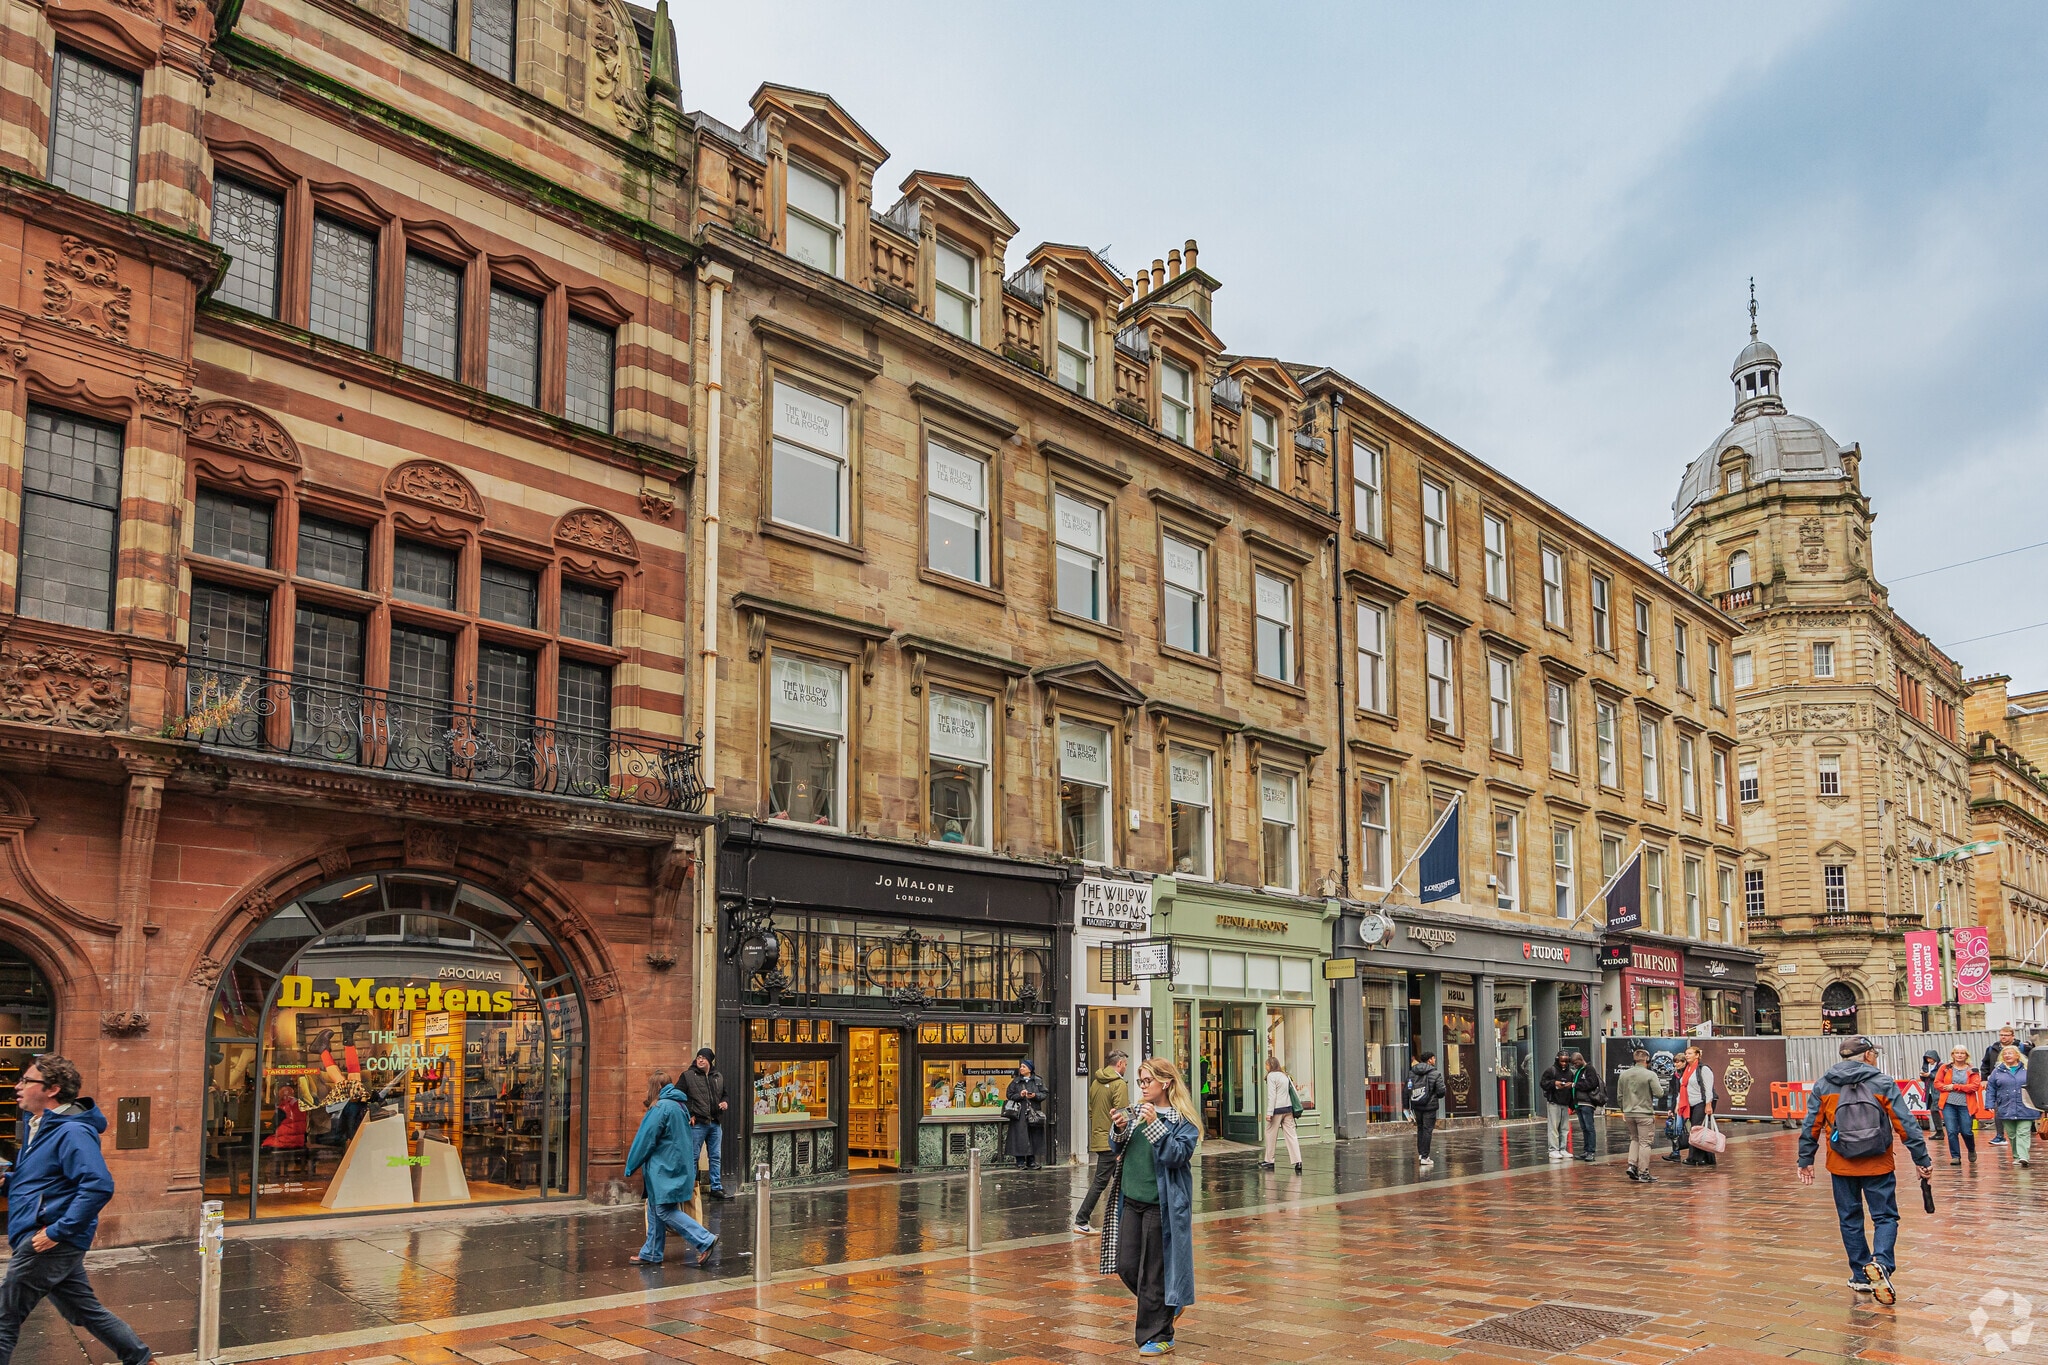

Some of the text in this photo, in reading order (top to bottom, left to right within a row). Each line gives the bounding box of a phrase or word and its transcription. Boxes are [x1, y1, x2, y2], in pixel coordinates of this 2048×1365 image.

[785, 403, 829, 428] THE WILLOW
[785, 413, 828, 437] TEA ROOMS
[936, 461, 972, 482] THE WILLOW
[937, 470, 972, 491] TEA ROOMS
[1061, 510, 1092, 528] THE WILLOW
[1062, 519, 1091, 536] TEA ROOMS
[782, 680, 829, 698] THE WILLOW
[783, 690, 827, 707] TEA ROOMS
[937, 714, 975, 730] THE WILLOW
[938, 723, 974, 738] TEA ROOMS
[1065, 740, 1097, 755] THE WILLOW
[1066, 749, 1097, 762] TEA ROOMS
[897, 877, 954, 893] MALONE
[1081, 883, 1147, 904] THE WILLOW
[895, 894, 934, 904] LONDON
[1081, 900, 1147, 920] TEA ROOMS
[1086, 918, 1116, 928] MACKINTOSH
[1610, 914, 1637, 926] TUDOR
[1408, 926, 1456, 943] LONGINES
[1531, 945, 1564, 960] TUDOR
[1632, 953, 1677, 972] TIMPSON
[1912, 943, 1923, 997] Celebrating
[1923, 945, 1934, 991] 850 years
[1961, 967, 1984, 978] 850
[369, 1031, 398, 1045] THE
[390, 1043, 420, 1057] ART
[366, 1057, 440, 1071] COMFORT
